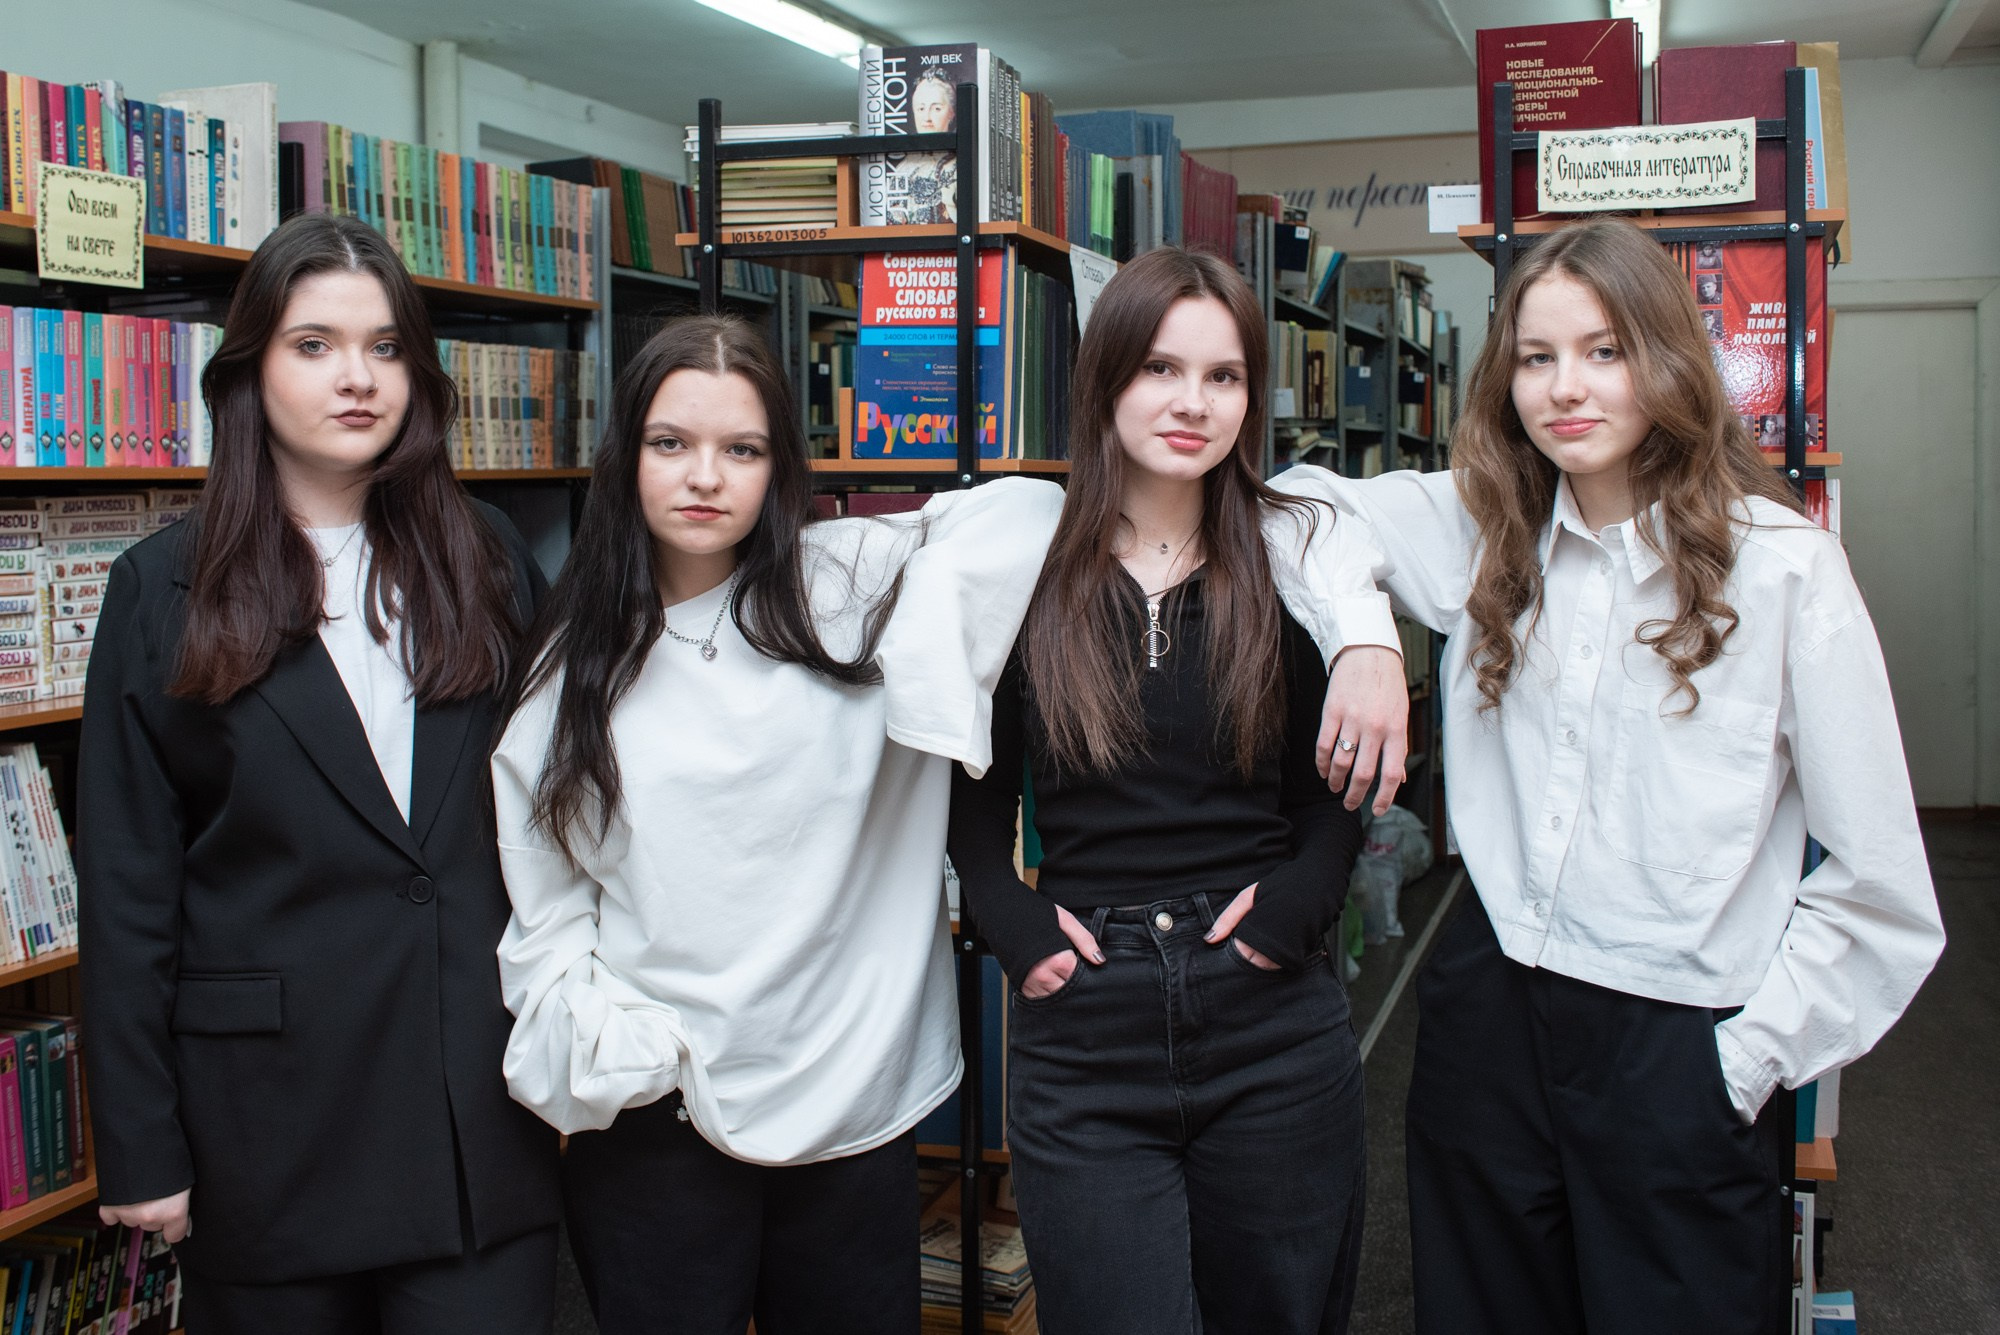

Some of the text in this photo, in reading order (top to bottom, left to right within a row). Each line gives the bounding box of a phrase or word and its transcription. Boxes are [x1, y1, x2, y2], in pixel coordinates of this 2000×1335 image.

[920, 53, 962, 65] XVIII ВЕК
[1506, 58, 1544, 70] НОВЫЕ
[1506, 66, 1594, 80] ИССЛЕДОВАНИЯ
[1513, 77, 1603, 91] МОЦИОНАЛЬНО-
[1512, 87, 1579, 102] ЕННОСТНОЙ
[1005, 73, 1013, 140] ЛЕКСИКОН
[1512, 102, 1548, 112] ФЕРЫ
[1514, 111, 1566, 123] ИЧНОСТИ
[13, 108, 21, 143] ВСЕХ
[55, 120, 64, 155] ВСЕХ
[77, 124, 85, 158] ВСЕХ
[92, 127, 102, 160] ВСЕХ
[133, 135, 144, 161] МИР
[14, 147, 22, 174] ОБО
[214, 152, 224, 179] МИР
[1805, 140, 1817, 184] Русский
[1558, 153, 1732, 189] Справочная литература
[68, 189, 89, 215] Обо
[732, 228, 828, 243] 101362013005
[67, 235, 80, 252] на
[895, 289, 957, 306] СЛОВАР
[876, 307, 936, 323] русского
[1748, 302, 1787, 315] ЖИВ
[1747, 317, 1786, 330] ПАМЯ
[883, 333, 906, 341] 24000
[907, 333, 928, 341] СЛОВ
[929, 333, 936, 341] И
[1733, 329, 1817, 345] ПОКОЛЕЙ
[857, 401, 997, 454] Русскй
[62, 498, 137, 514] Я ПОЗНАЮ МИР
[31, 515, 39, 529] Я
[69, 521, 89, 534] МИР
[91, 519, 128, 532] ПОЗНАЮ
[20, 535, 28, 548] Я
[66, 543, 87, 556] МИР
[17, 556, 26, 569] Я
[71, 564, 93, 577] МИР
[77, 585, 98, 598] МИР
[20, 599, 29, 612] Я
[19, 634, 27, 647] Я
[23, 651, 31, 664] Я
